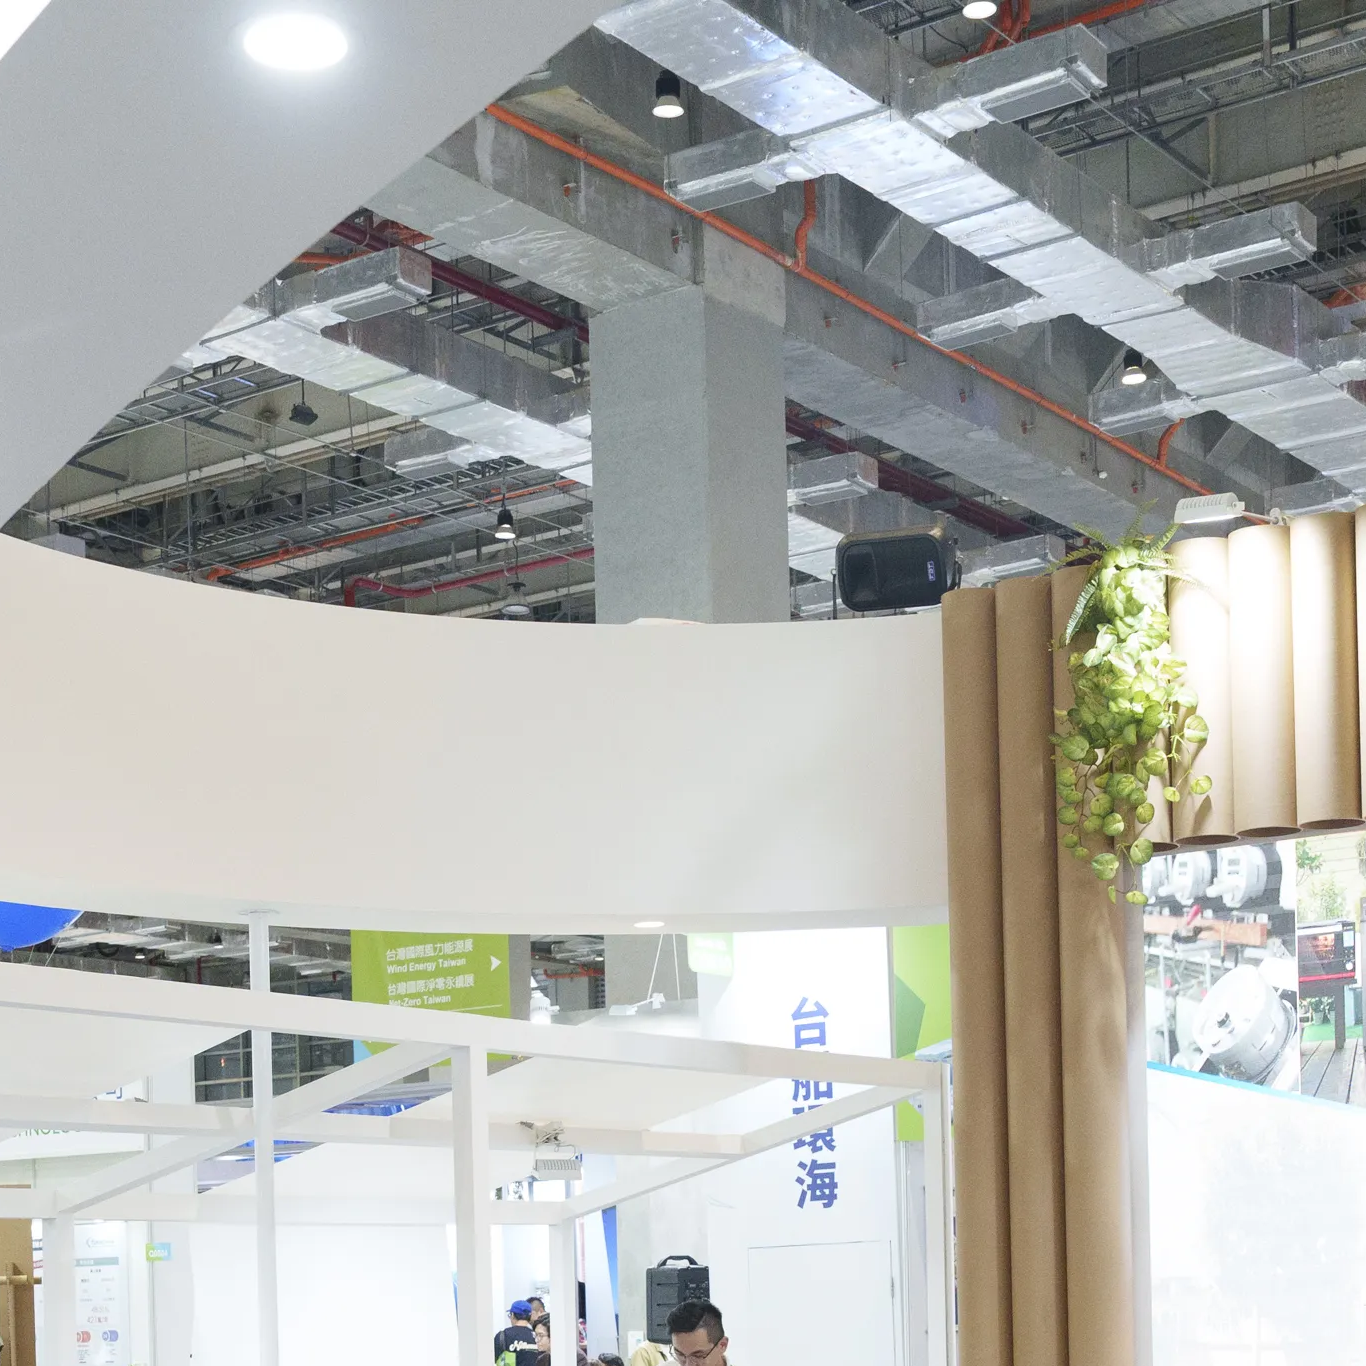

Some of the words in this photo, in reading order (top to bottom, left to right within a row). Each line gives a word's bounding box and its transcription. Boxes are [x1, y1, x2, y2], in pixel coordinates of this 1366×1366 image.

[387, 963, 407, 974] Wind
[409, 961, 436, 972] Energy
[438, 957, 466, 968] Taiwan
[423, 995, 451, 1005] Taiwan
